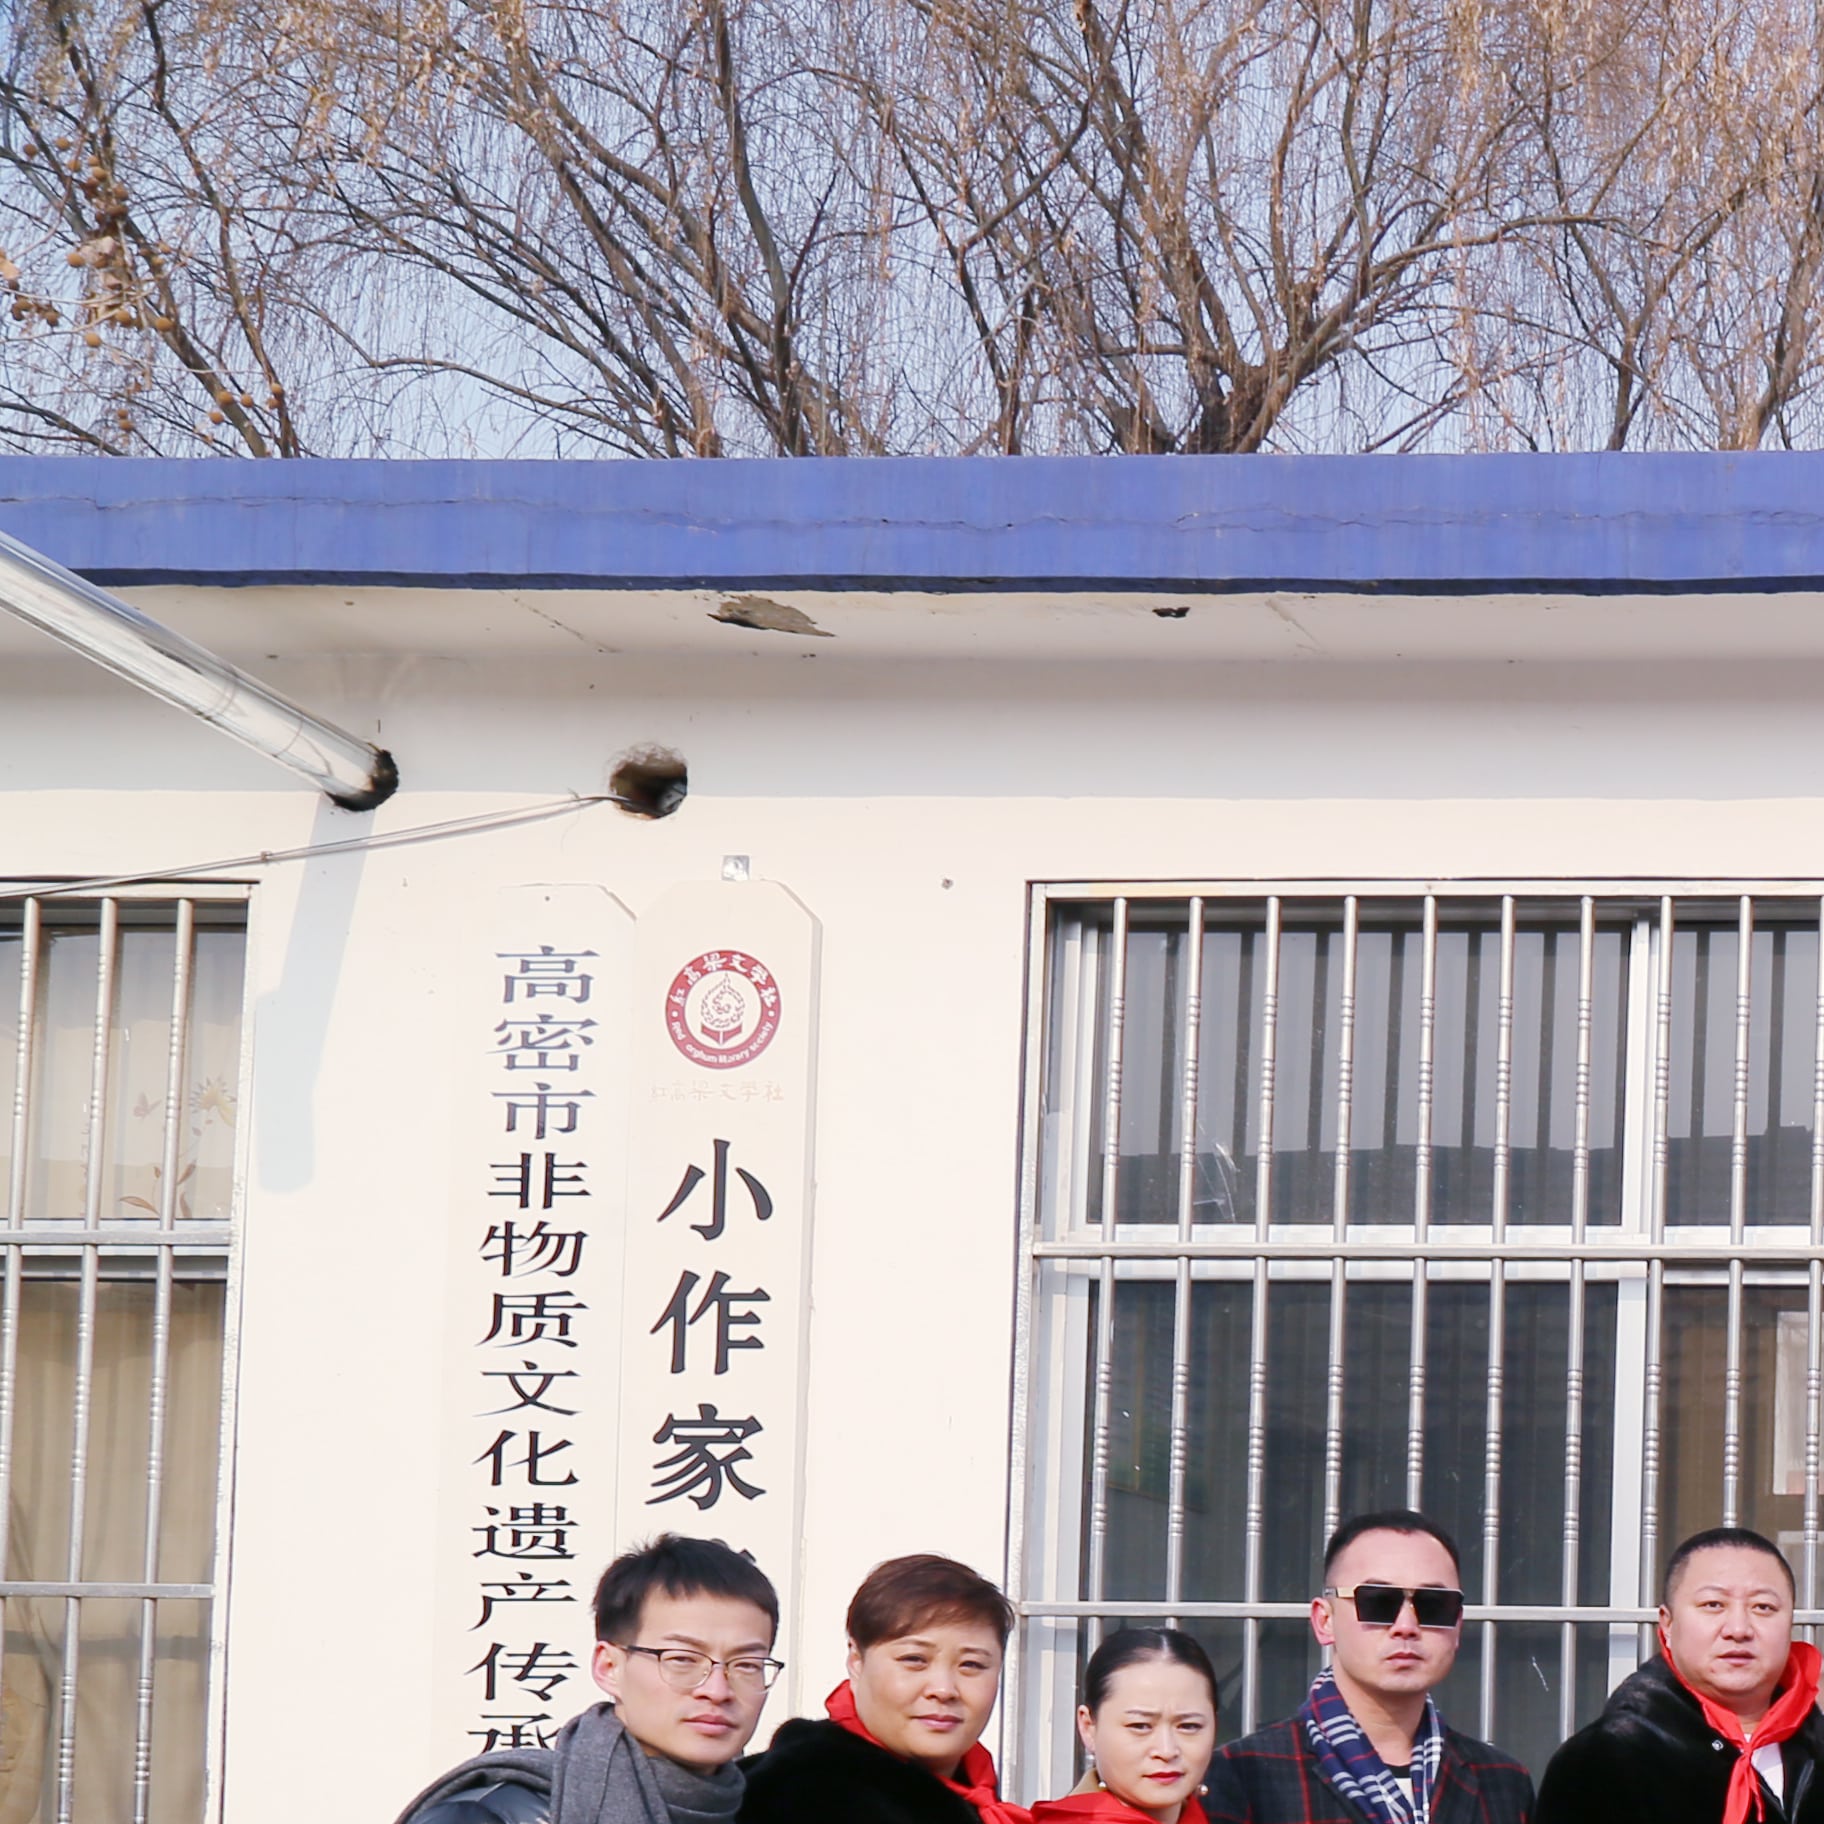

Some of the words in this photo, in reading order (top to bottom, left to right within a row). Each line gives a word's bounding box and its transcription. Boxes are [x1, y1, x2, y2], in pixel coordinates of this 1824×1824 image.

[464, 945, 602, 1754] 高密市非物质文化遗产传承
[646, 1138, 773, 1562] 小作家
